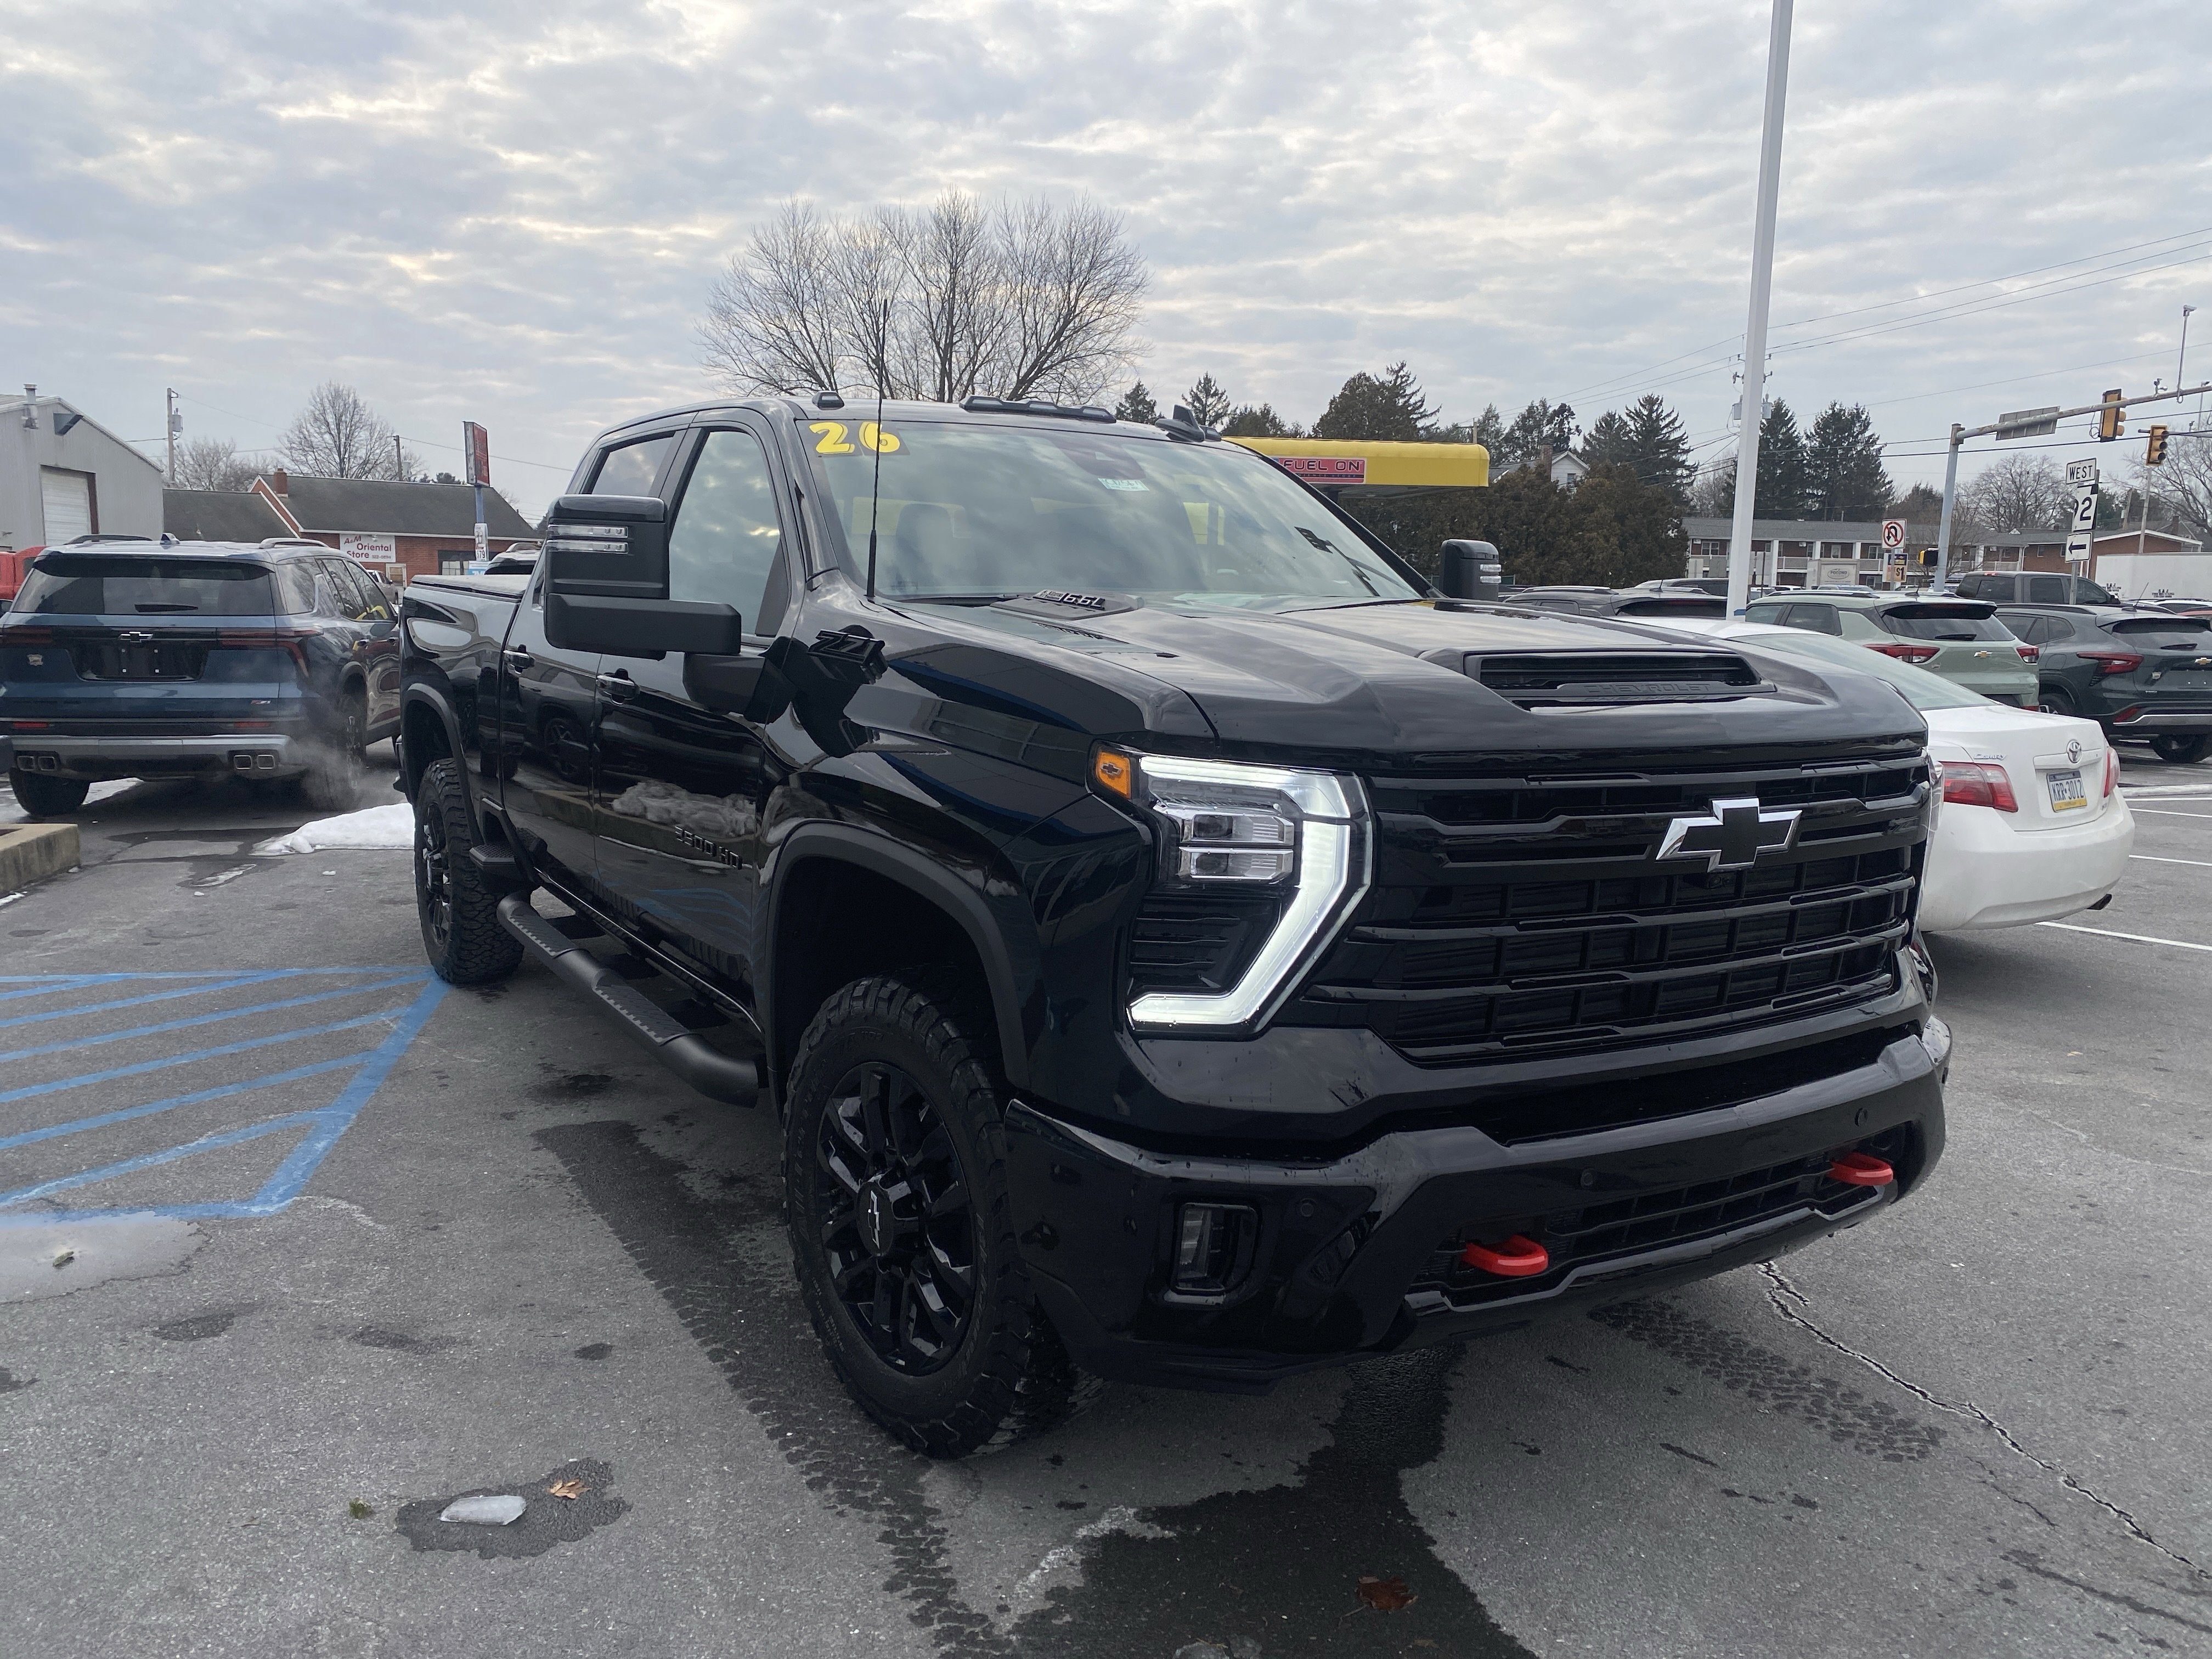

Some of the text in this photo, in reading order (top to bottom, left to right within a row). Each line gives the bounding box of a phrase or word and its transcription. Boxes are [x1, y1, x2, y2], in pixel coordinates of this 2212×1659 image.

[809, 421, 900, 454] 26
[1283, 460, 1359, 471] FUEL ON
[2069, 465, 2092, 481] WEST
[344, 535, 362, 544] A&M
[357, 543, 391, 551] Oriental
[1583, 684, 1710, 693] CHEVROLET
[718, 846, 742, 870] HD
